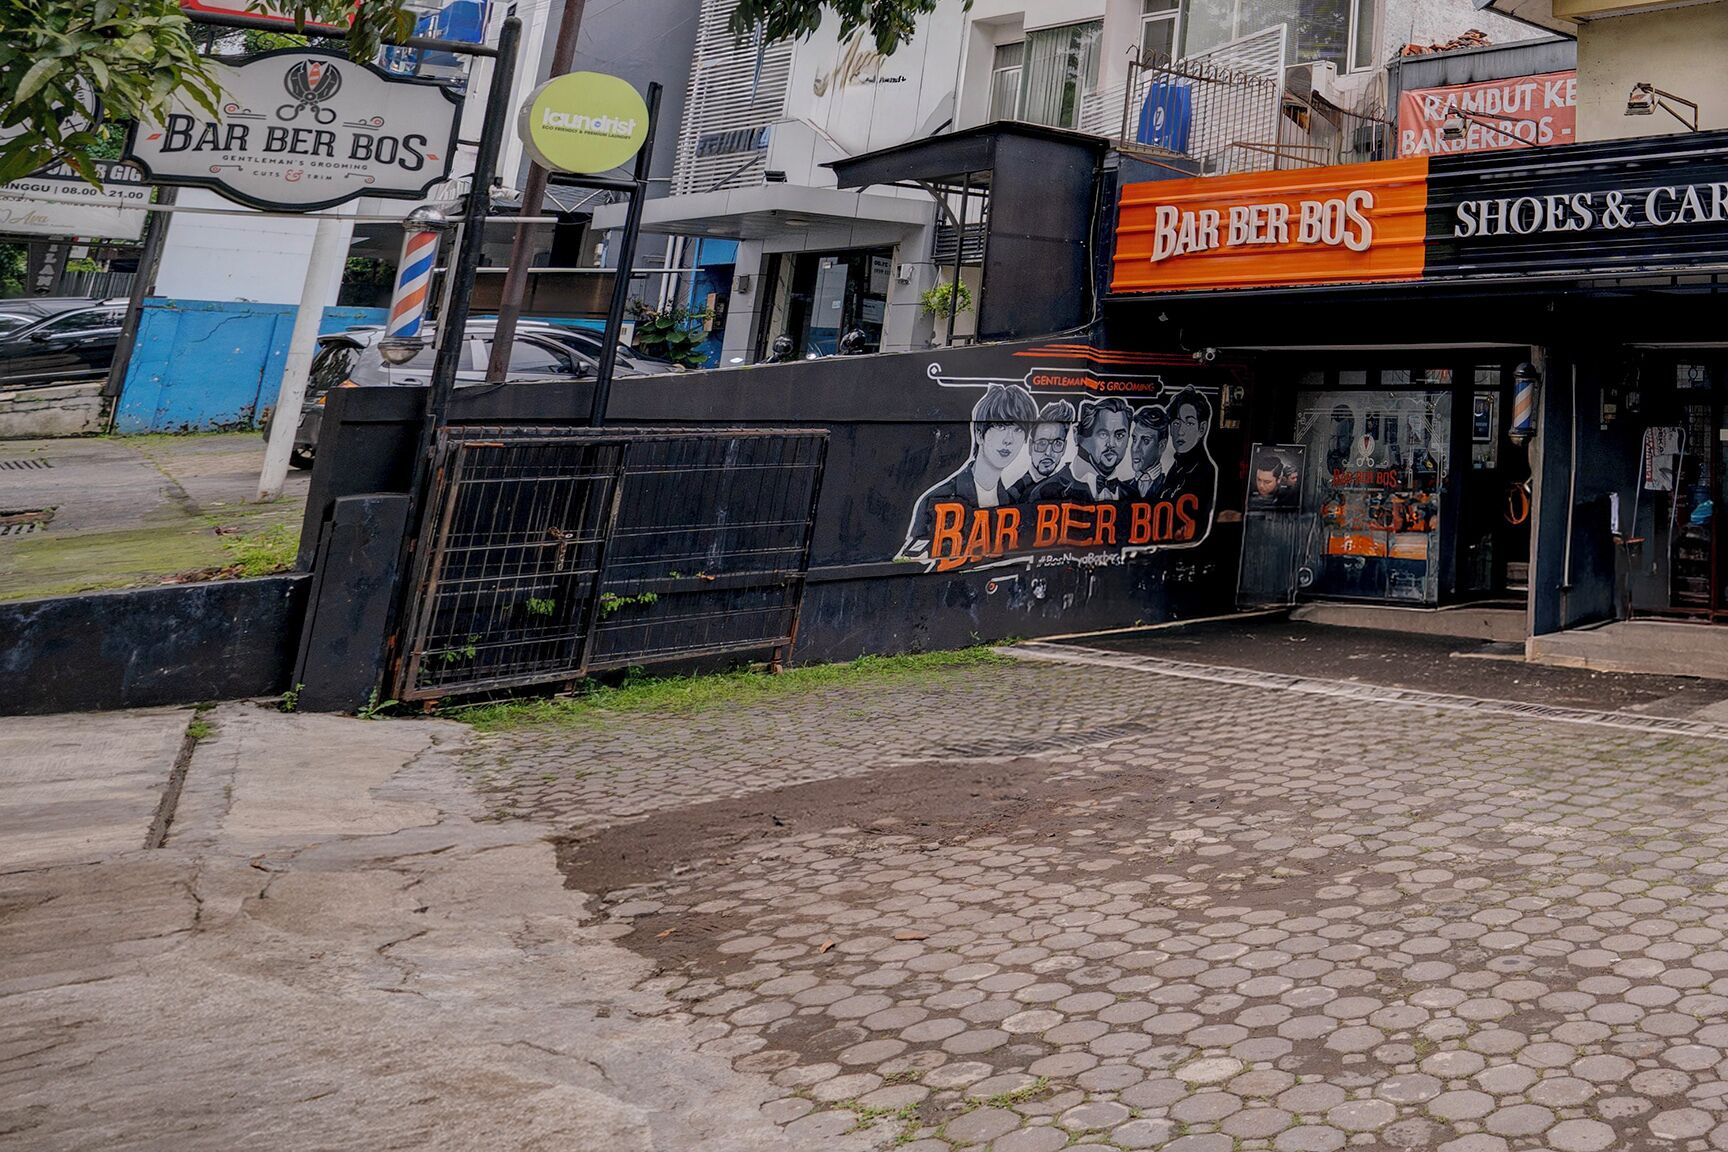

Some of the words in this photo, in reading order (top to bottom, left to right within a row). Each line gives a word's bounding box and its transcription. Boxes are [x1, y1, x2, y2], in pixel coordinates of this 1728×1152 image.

[1423, 83, 1537, 121] RAMBUT
[543, 107, 636, 135] laundrist
[159, 113, 249, 153] BAR
[263, 125, 337, 158] BER
[348, 133, 428, 172] BOS
[1402, 116, 1553, 155] BARBERBOS
[110, 165, 141, 182] GIG
[222, 155, 304, 166] GENTLEMAN'S
[310, 161, 368, 170] GROOMING
[253, 170, 280, 178] CUTS
[284, 169, 303, 182] &
[62, 186, 97, 196] 08.00
[109, 190, 143, 199] 21.00
[1150, 205, 1220, 263] BAR
[1227, 203, 1289, 246] BER
[1297, 189, 1374, 252] BOS
[1454, 192, 1594, 238] SHOES
[1602, 190, 1635, 229] &
[1106, 382, 1155, 391] GROOMING
[1376, 469, 1397, 488] BOS
[932, 502, 1021, 572] BAR
[1033, 502, 1117, 548] BER
[1128, 494, 1199, 546] BOS
